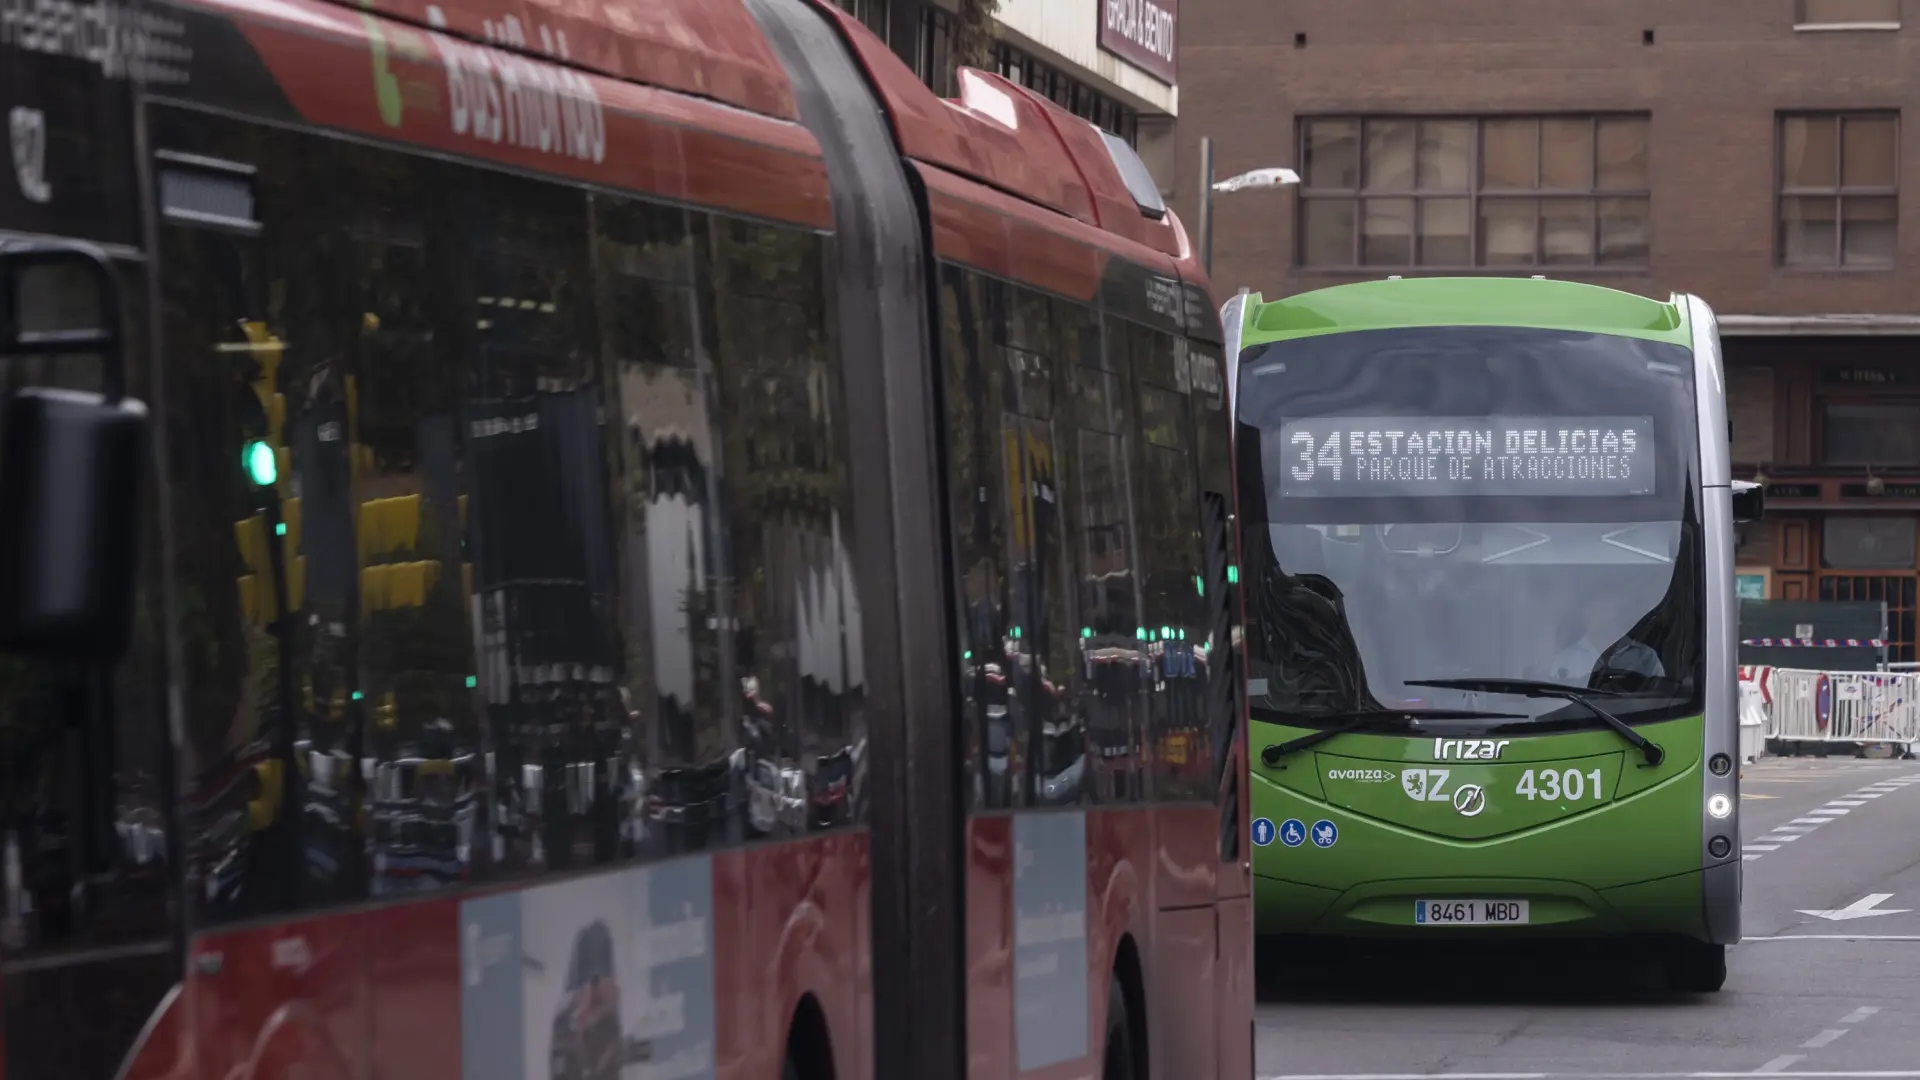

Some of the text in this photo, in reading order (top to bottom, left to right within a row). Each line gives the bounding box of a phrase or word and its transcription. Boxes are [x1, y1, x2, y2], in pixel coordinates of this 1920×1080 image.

[1145, 1, 1173, 62] BENITO
[1350, 429, 1637, 455] ESTACION DELICIAS
[1291, 431, 1343, 481] 34
[1357, 455, 1631, 480] PARQUE DE ATRACCIONES
[1433, 737, 1510, 760] Irizar
[1328, 769, 1382, 780] avanza
[1516, 768, 1602, 801] 4301
[1430, 902, 1475, 922] 8461
[1485, 902, 1520, 921] MBD
